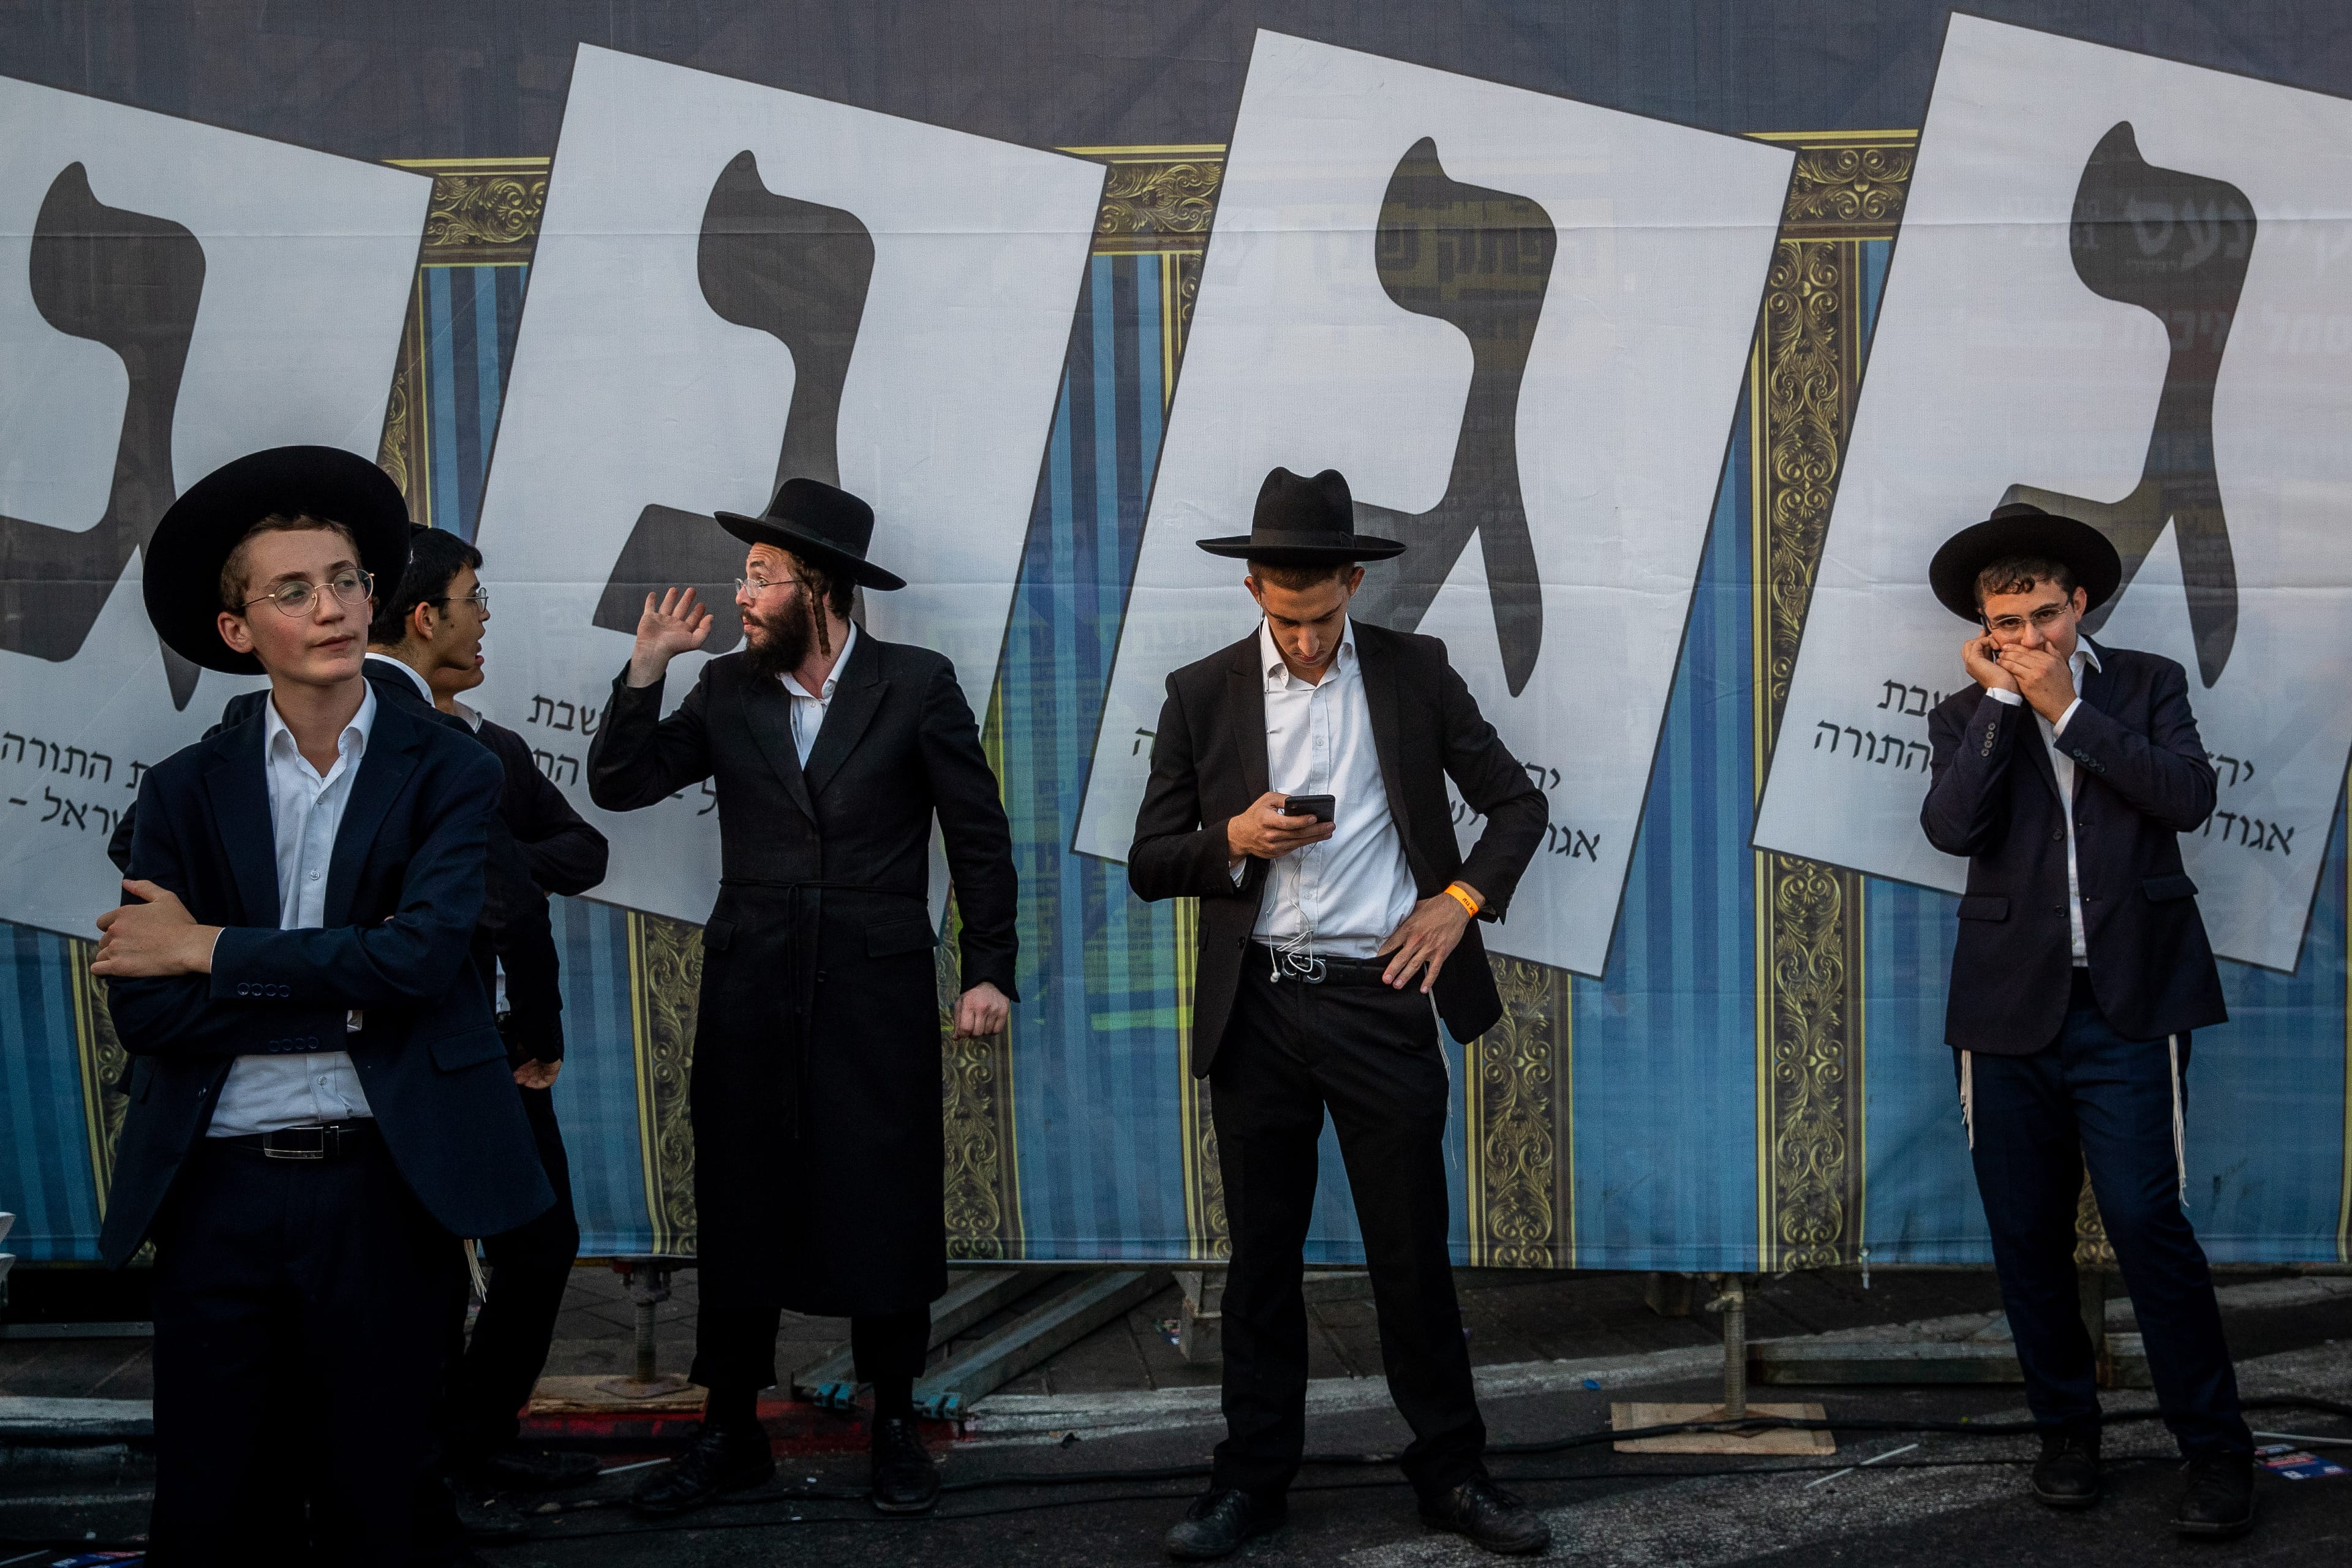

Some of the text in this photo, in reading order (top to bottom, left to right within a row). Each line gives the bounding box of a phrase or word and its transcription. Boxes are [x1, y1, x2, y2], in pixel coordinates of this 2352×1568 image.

[1, 731, 112, 783] התורה
[1814, 720, 1931, 774] התורה
[2203, 810, 2294, 856] אגוד
